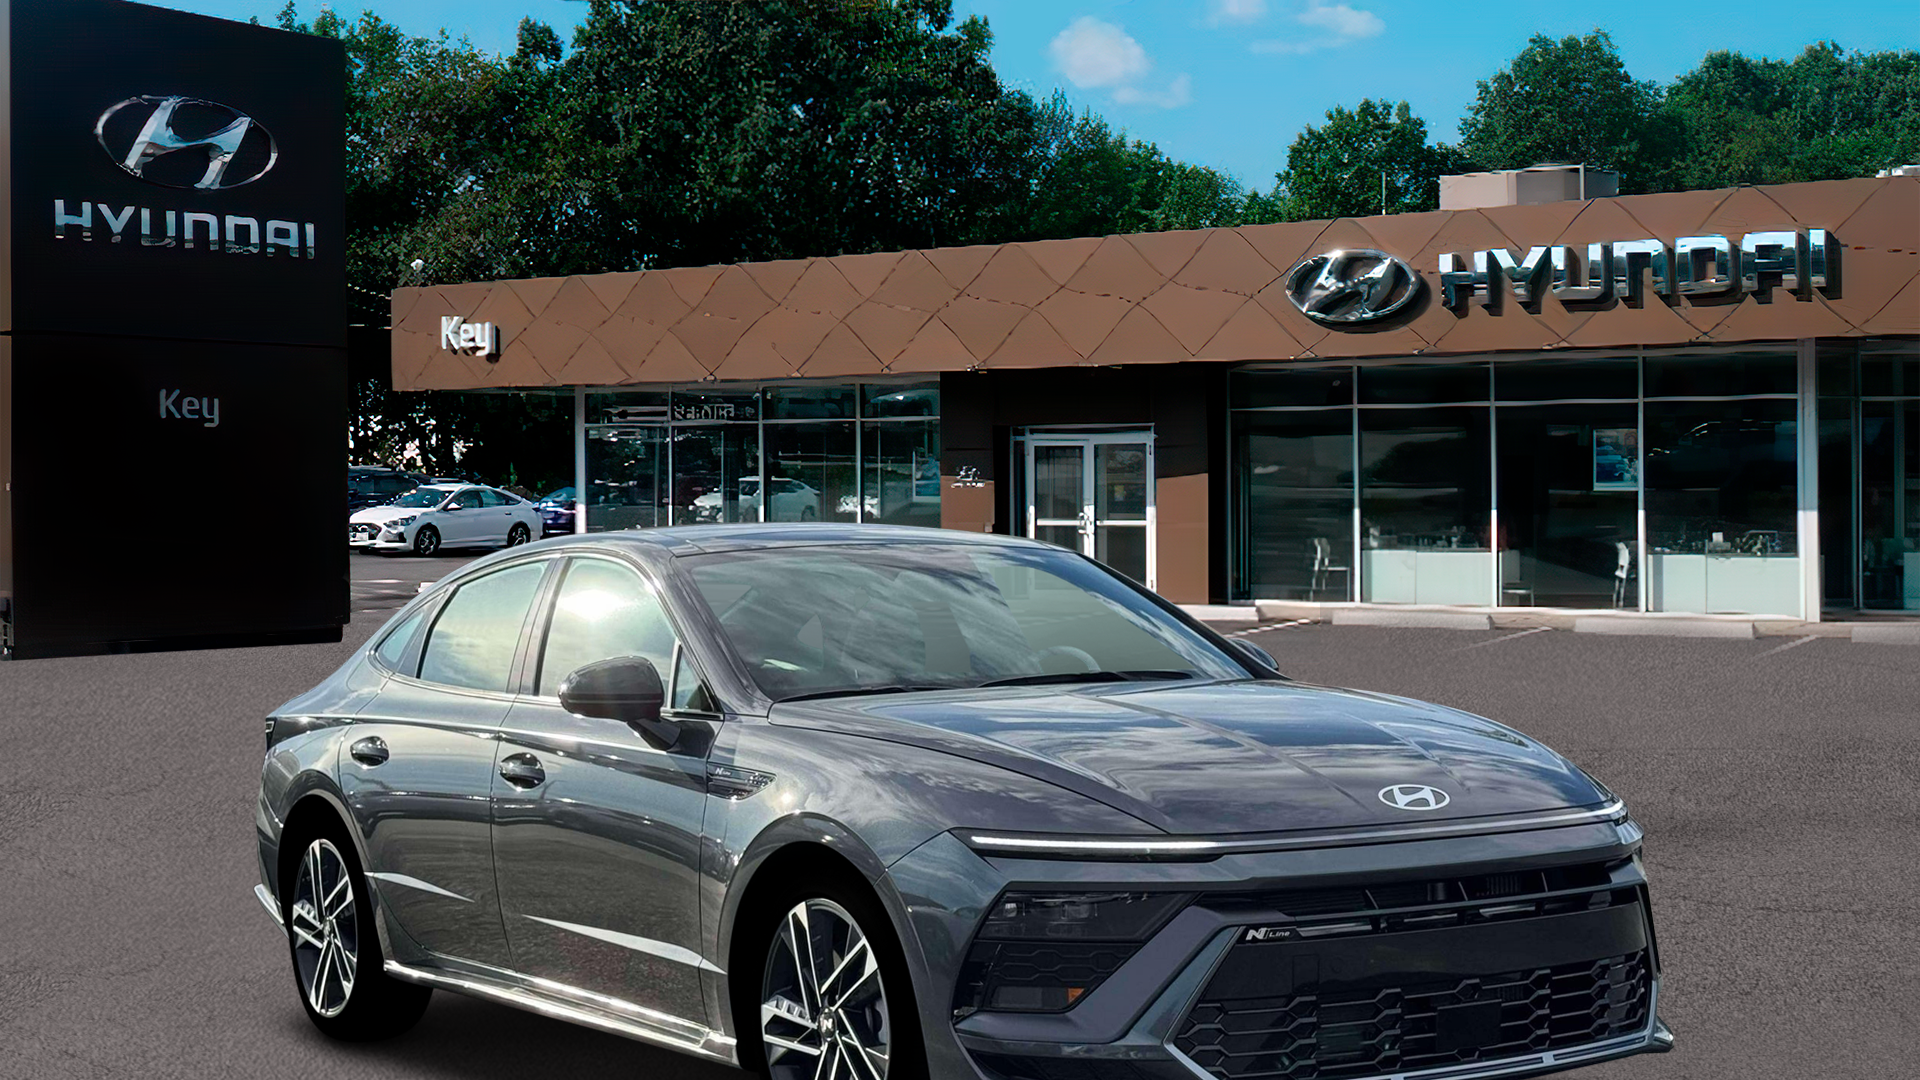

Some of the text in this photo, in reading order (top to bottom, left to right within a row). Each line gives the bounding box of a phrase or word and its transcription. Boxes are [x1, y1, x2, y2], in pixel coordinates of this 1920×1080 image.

[54, 199, 315, 260] HYUNDAI
[1439, 228, 1834, 312] HYUNDAI
[441, 316, 493, 357] Key
[159, 388, 219, 427] Key
[1245, 927, 1267, 940] N
